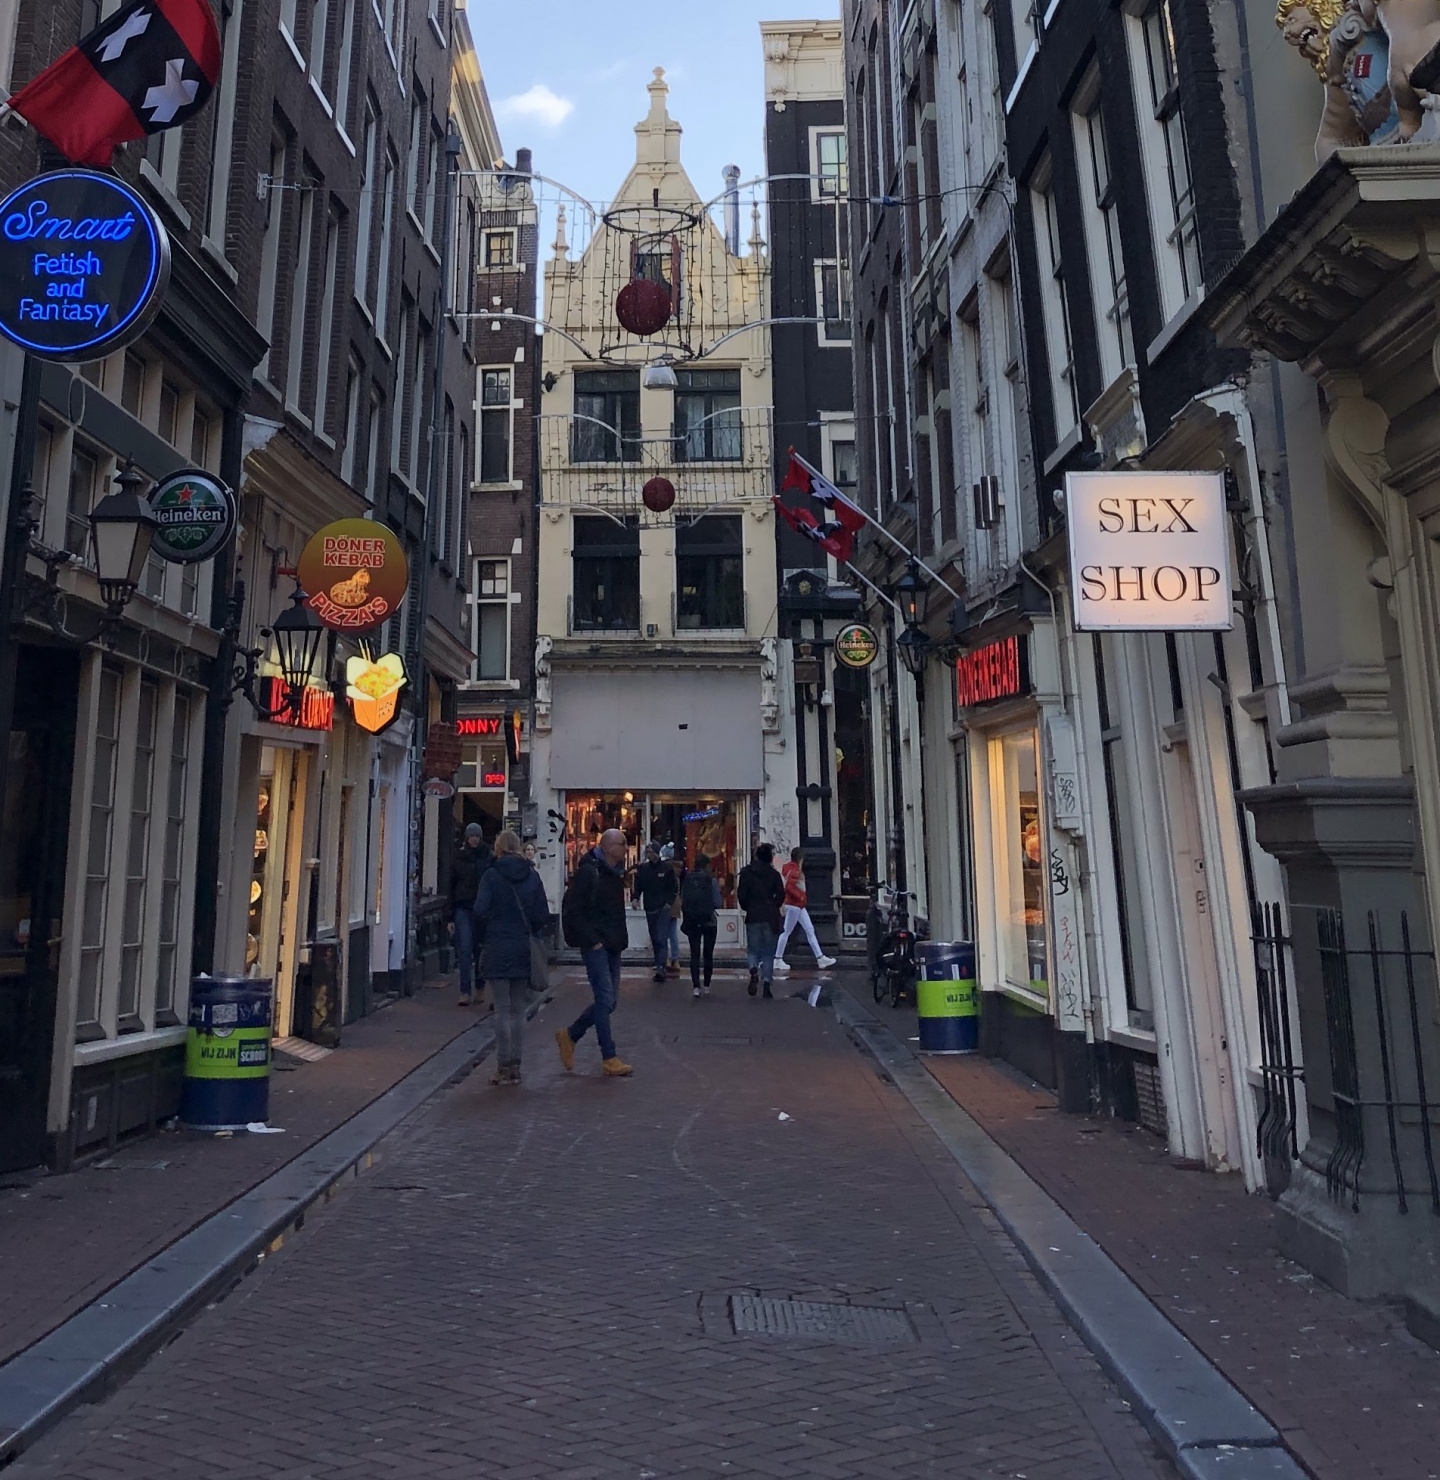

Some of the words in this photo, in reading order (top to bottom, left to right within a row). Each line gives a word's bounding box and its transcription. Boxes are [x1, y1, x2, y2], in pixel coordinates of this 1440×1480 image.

[4, 200, 135, 240] Smart
[33, 251, 101, 275] Fetish
[46, 278, 84, 298] and
[19, 298, 109, 328] Fantasy
[1098, 497, 1198, 534] SEX
[323, 535, 386, 553] DÖNER
[323, 552, 384, 567] KEBAB
[1080, 565, 1221, 602] SHOP
[309, 591, 388, 626] PIZZA'S
[840, 641, 874, 649] Heineken
